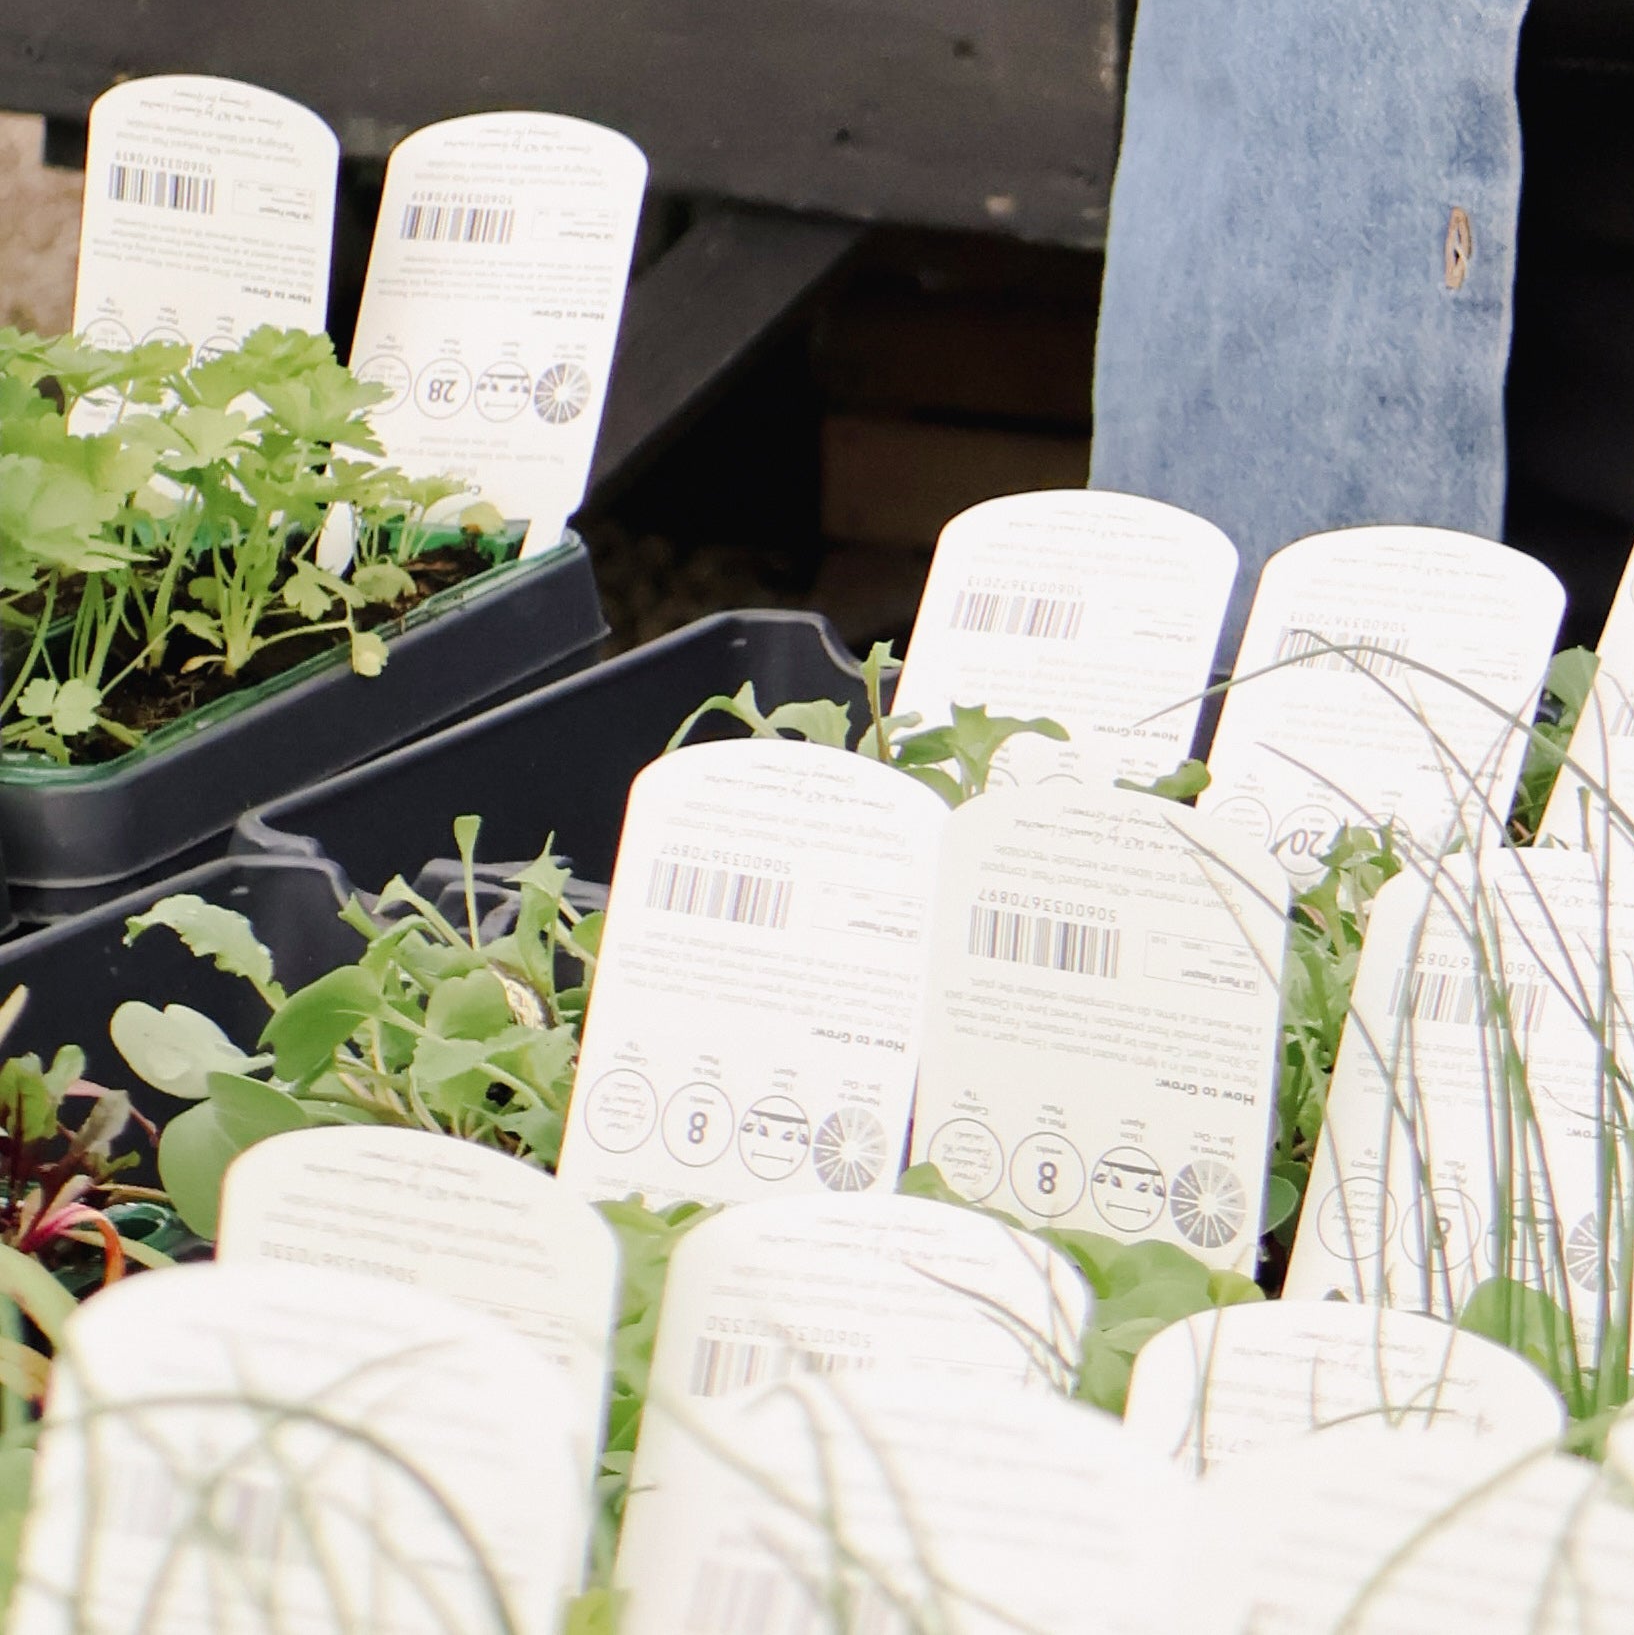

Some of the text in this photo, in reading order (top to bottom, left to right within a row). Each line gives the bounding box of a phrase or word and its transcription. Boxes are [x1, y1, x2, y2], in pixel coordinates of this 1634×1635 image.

[427, 376, 457, 404] 28
[1288, 830, 1324, 858] 20
[978, 887, 1117, 921] 5060033670897
[854, 1033, 870, 1046] to
[873, 1037, 905, 1052] How
[1153, 1076, 1255, 1106] How to Grow:
[685, 1110, 708, 1145] 8
[1037, 1160, 1057, 1195] 8
